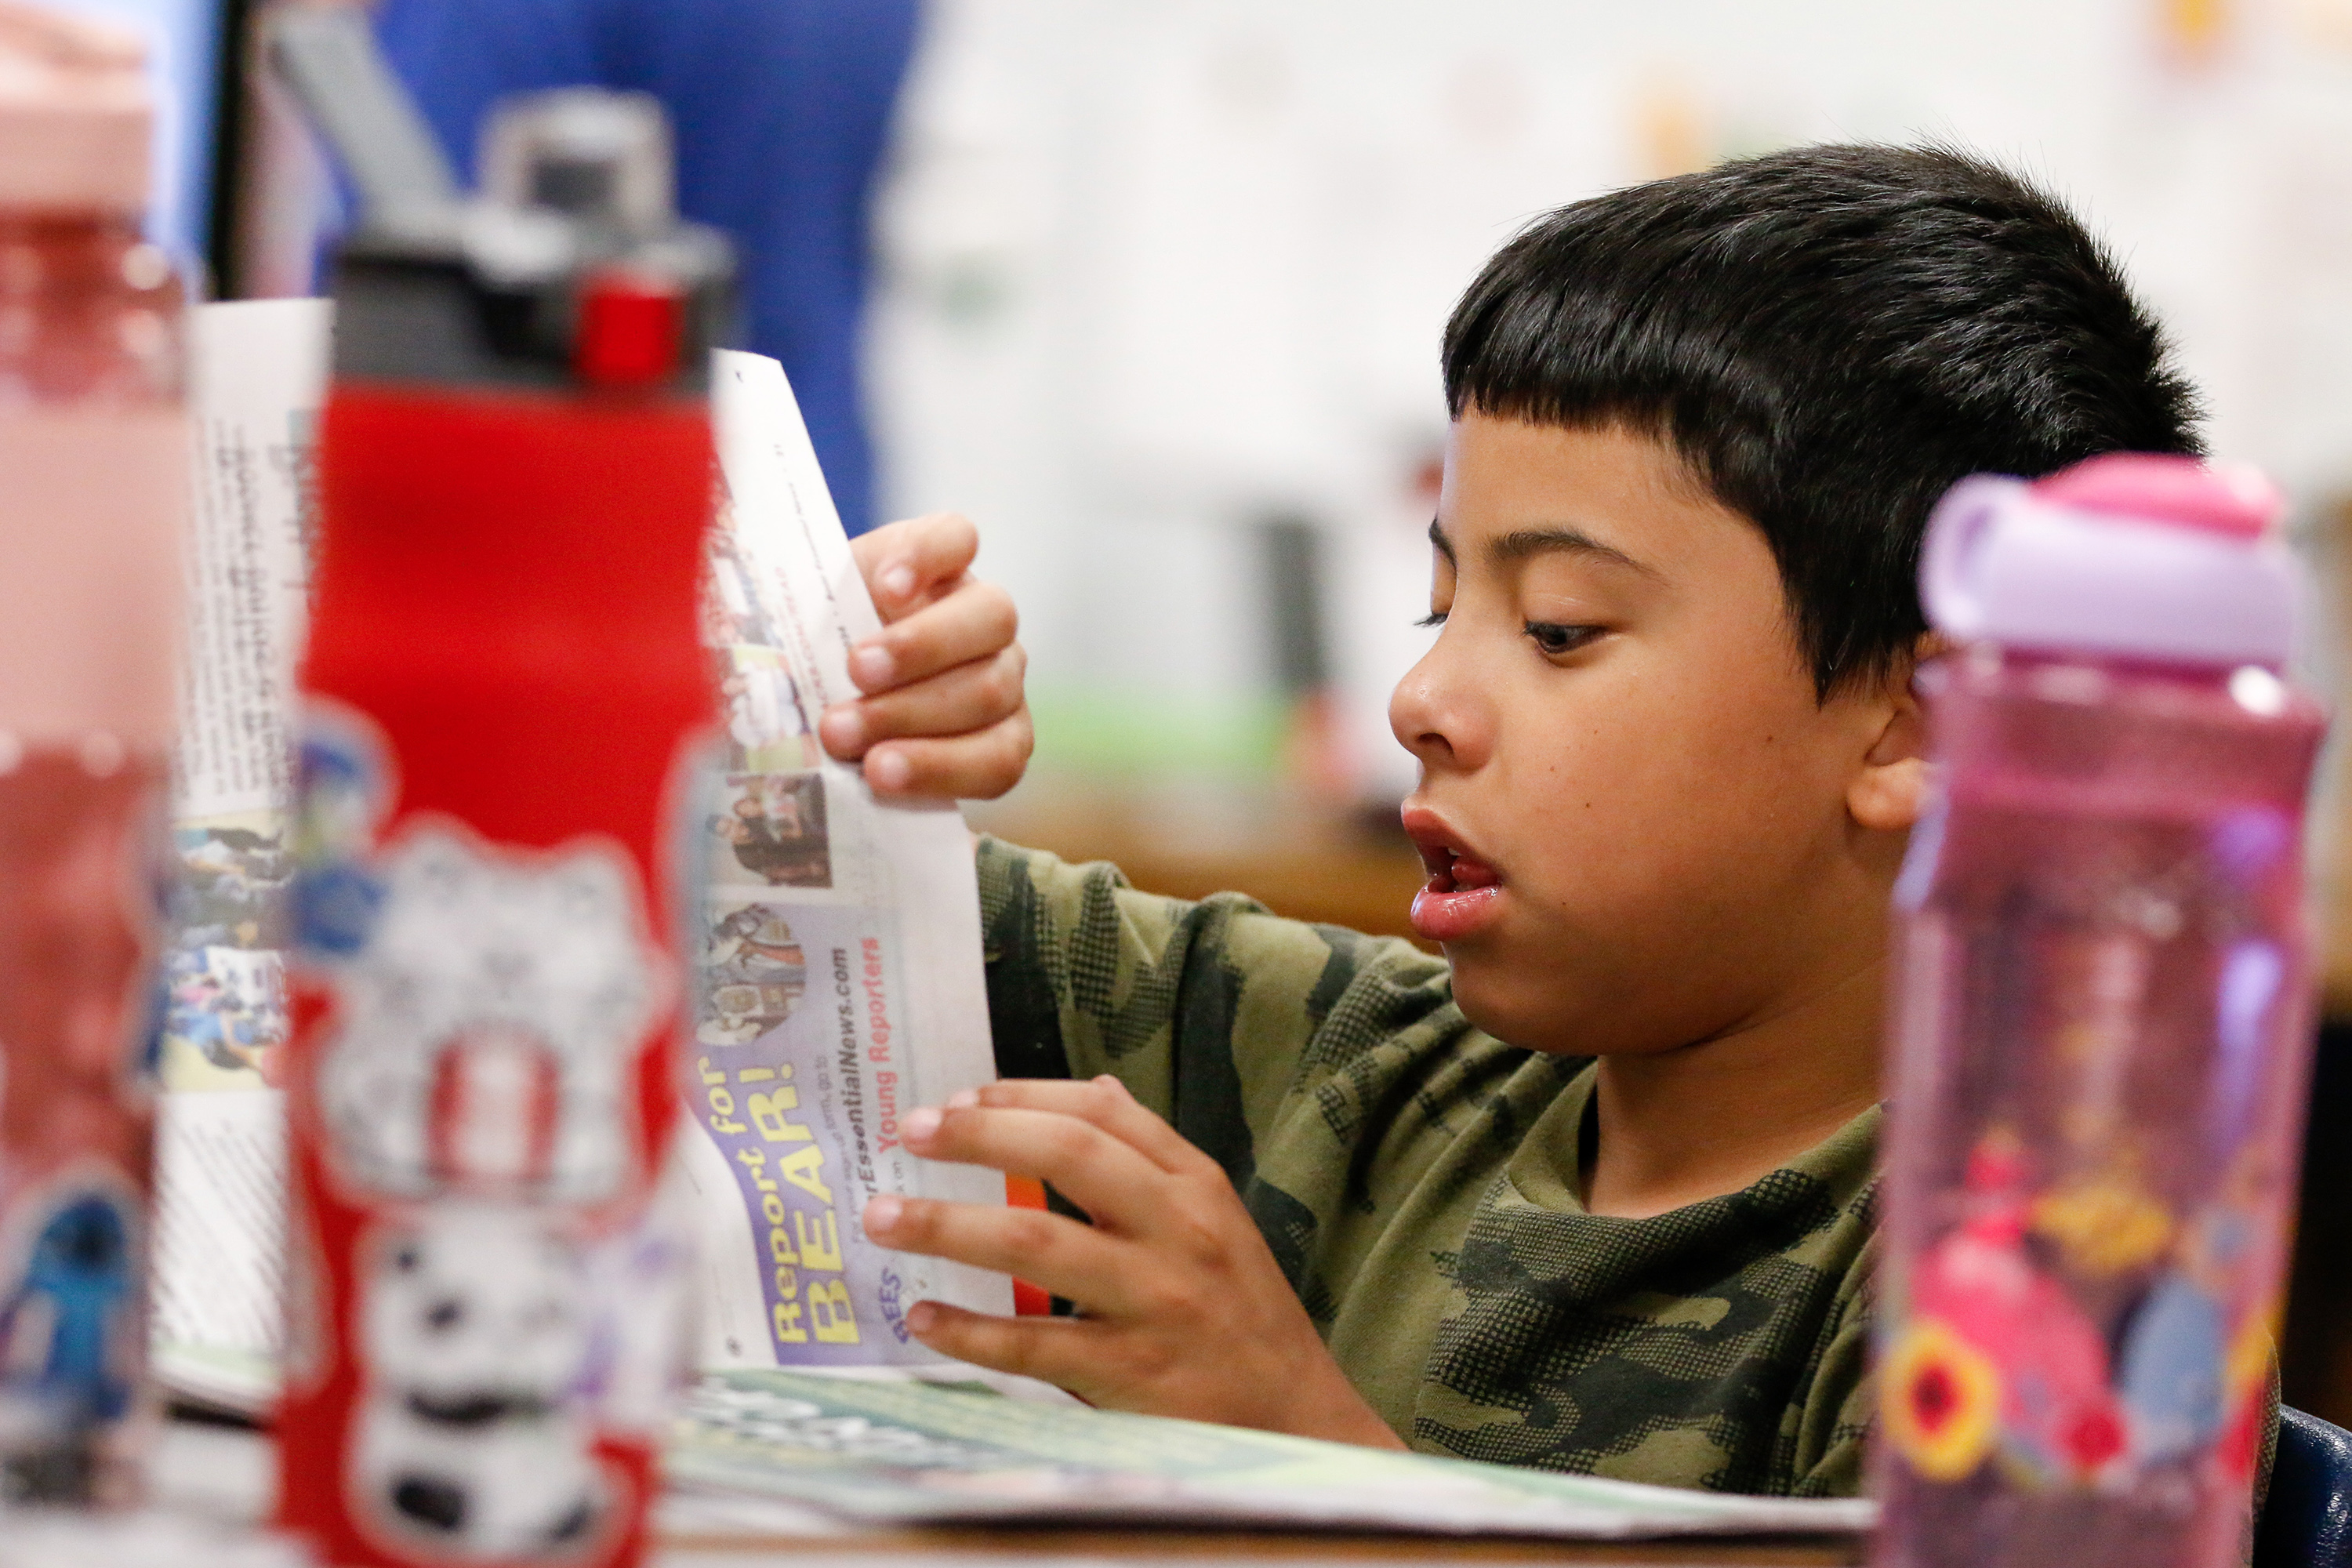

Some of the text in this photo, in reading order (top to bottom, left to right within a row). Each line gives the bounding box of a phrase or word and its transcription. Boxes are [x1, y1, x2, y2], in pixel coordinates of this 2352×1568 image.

[831, 947, 879, 1202] arEssentialNews.com
[860, 937, 891, 1063] Reporters
[875, 1069, 900, 1154] Young
[697, 1056, 808, 1344] Report for
[739, 1062, 860, 1344] BEAR!
